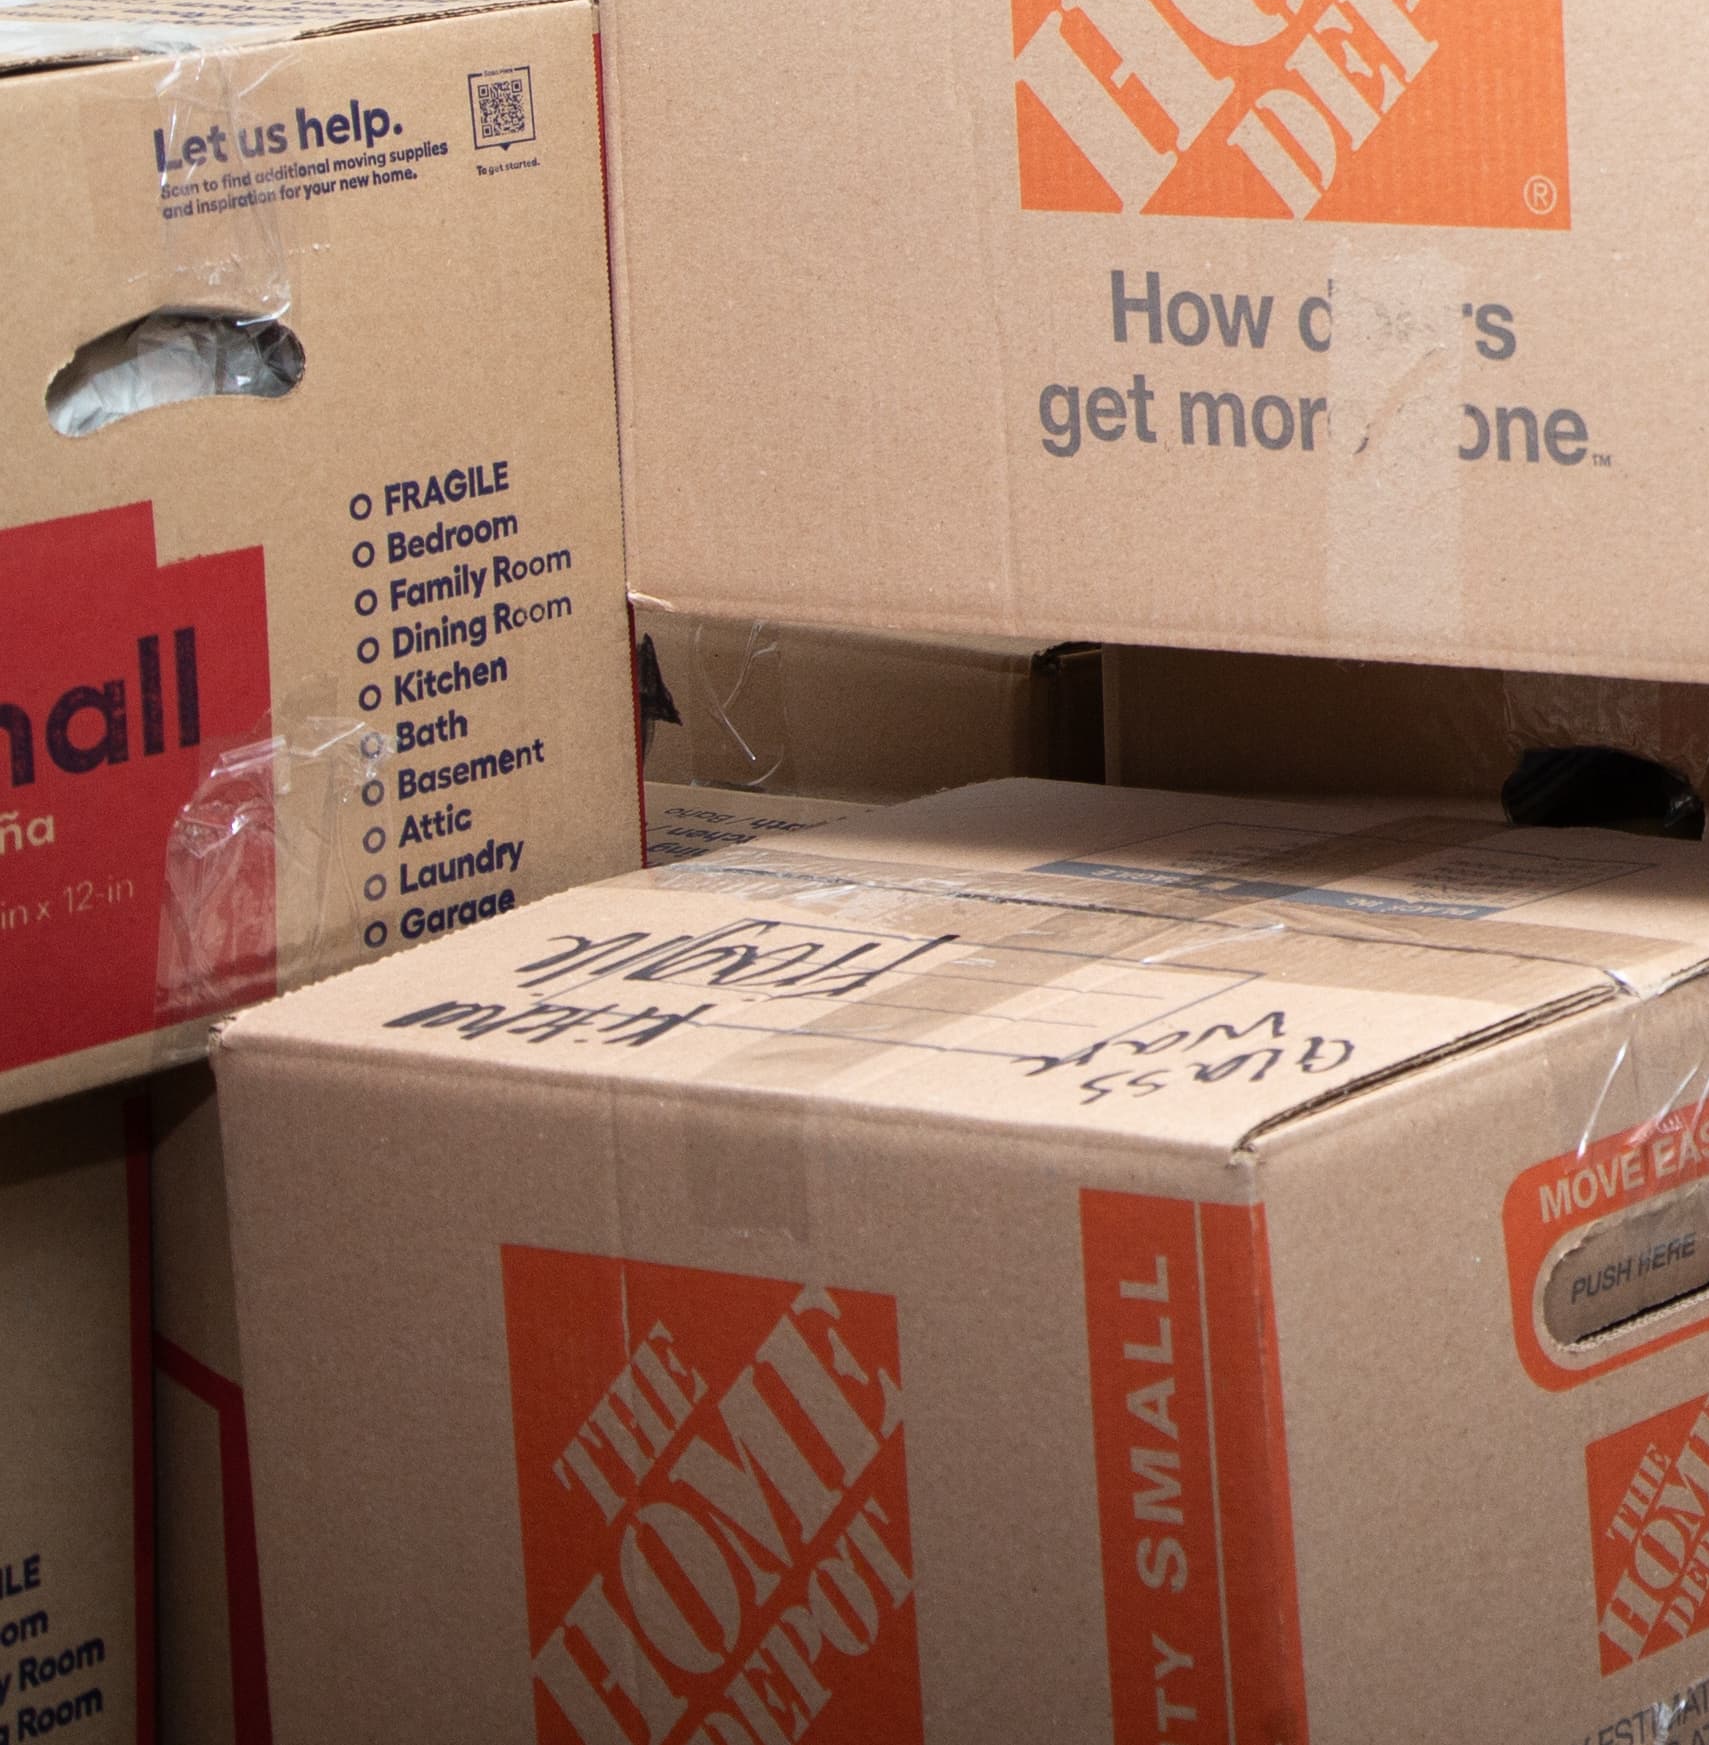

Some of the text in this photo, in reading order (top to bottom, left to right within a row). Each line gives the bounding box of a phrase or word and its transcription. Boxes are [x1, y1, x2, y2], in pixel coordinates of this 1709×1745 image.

[154, 99, 404, 173] Let us help.
[476, 157, 540, 176] To get started.
[161, 140, 449, 199] Scan to find additional moving supplies
[162, 166, 419, 220] and inspiration for your new home.
[1110, 269, 1274, 349] How
[1038, 373, 1157, 458] get
[1179, 390, 1332, 454] mor
[384, 461, 509, 516] FRAGILE
[387, 514, 519, 564] Bedroom
[389, 547, 572, 612] Family Room
[392, 594, 573, 659] Dining Room
[394, 656, 508, 706] Kitchen
[395, 710, 468, 754] Bath
[397, 738, 545, 801] Basement
[398, 805, 472, 849] Attic
[65, 875, 134, 915] 12-in
[399, 839, 525, 896] Laundry
[510, 920, 960, 1001] Fragile
[1540, 1155, 1646, 1224] MOVE
[1570, 1232, 1698, 1304] PUSH HERE
[553, 1320, 708, 1528] THE
[1119, 1255, 1188, 1595] SMALL
[532, 1285, 904, 1745] HOME
[1606, 1442, 1670, 1543] THE
[18, 1637, 106, 1692] Room
[17, 1687, 104, 1742] Room
